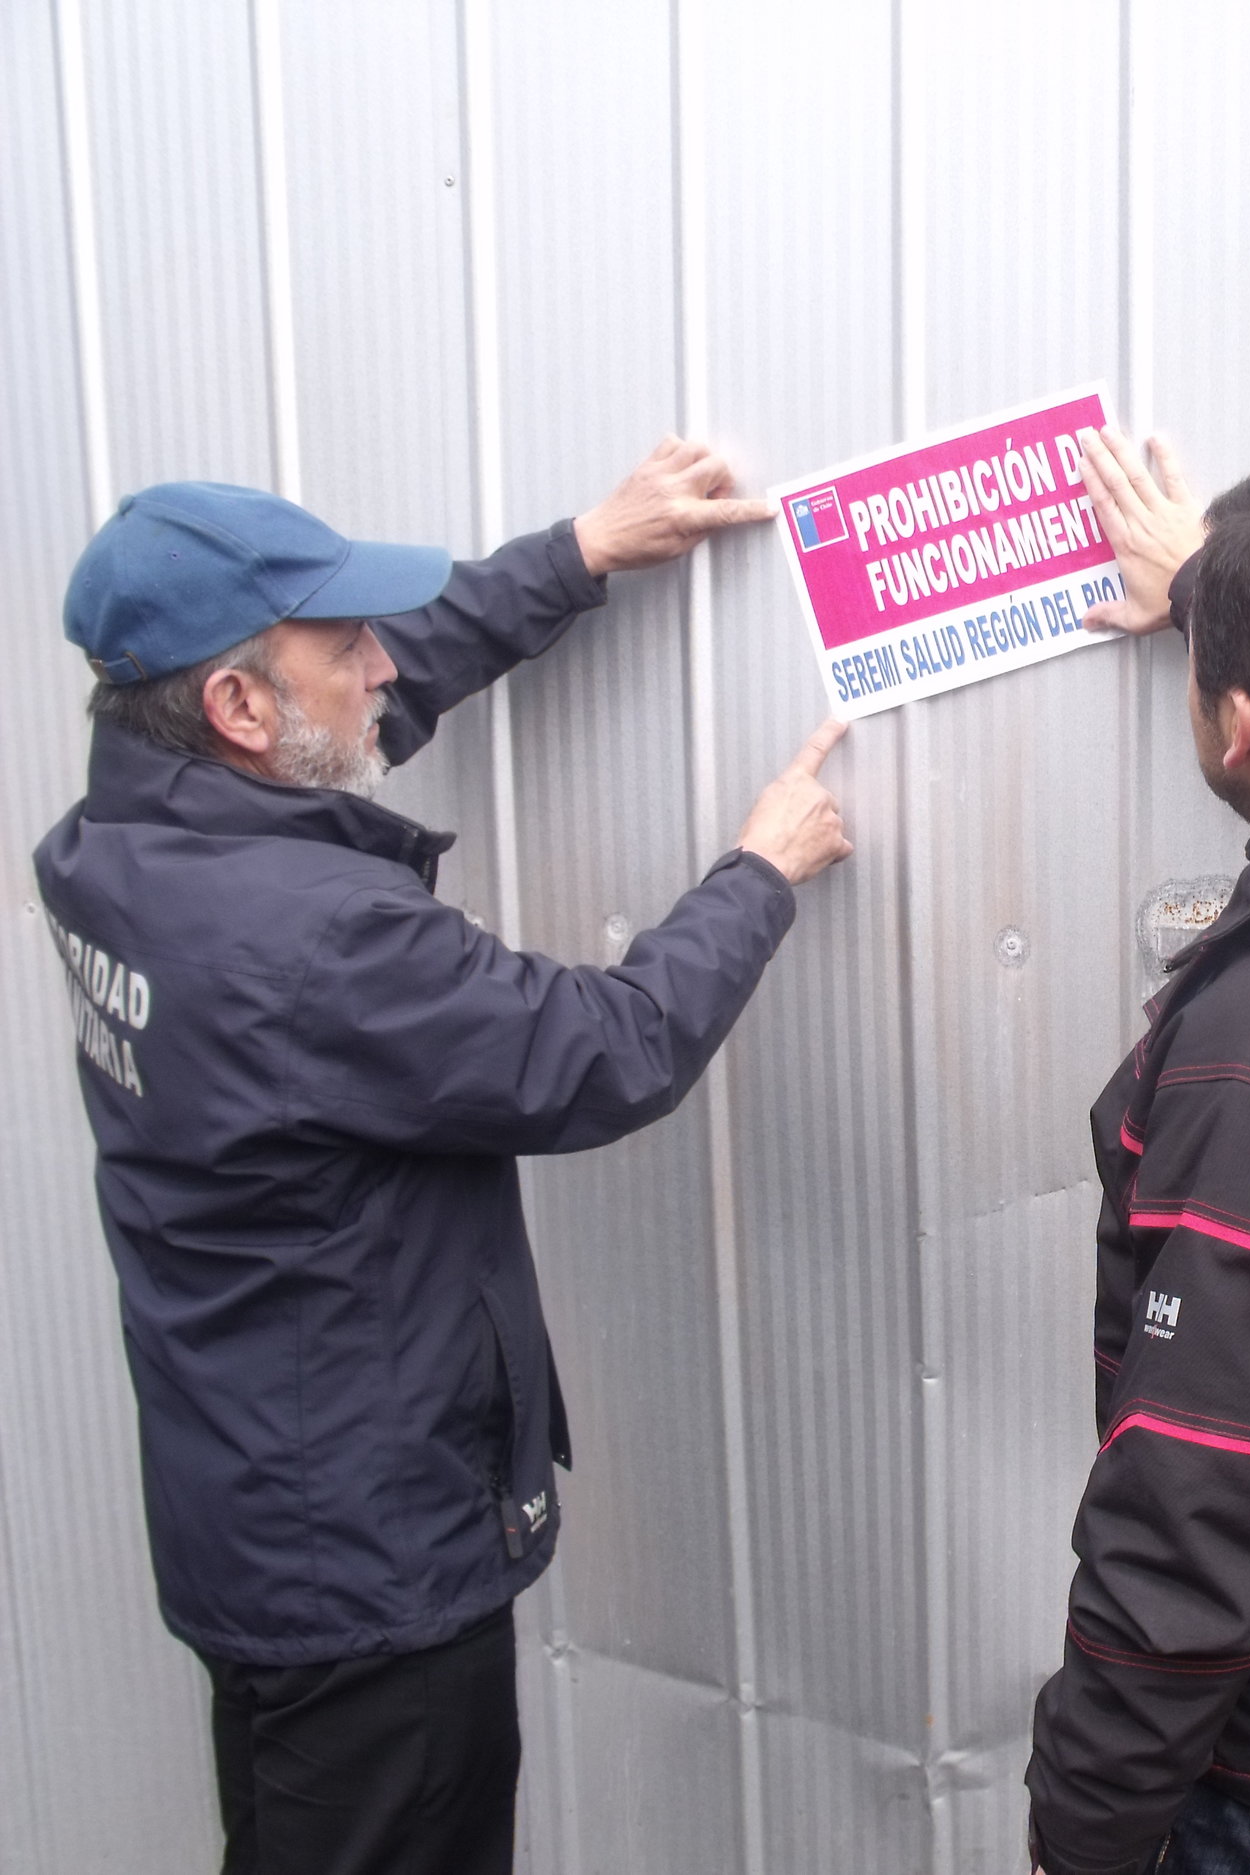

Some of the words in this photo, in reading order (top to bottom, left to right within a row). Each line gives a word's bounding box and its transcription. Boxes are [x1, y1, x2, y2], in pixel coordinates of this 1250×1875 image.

[848, 437, 1057, 552] PROHIBICIÓN
[865, 494, 1103, 612] FUNCIONAMIENT
[831, 643, 902, 703] SEREMI
[899, 624, 966, 682] SALUD
[963, 594, 1044, 660] REGIÓN
[1040, 589, 1084, 638] DEL
[1146, 1290, 1181, 1327] HH
